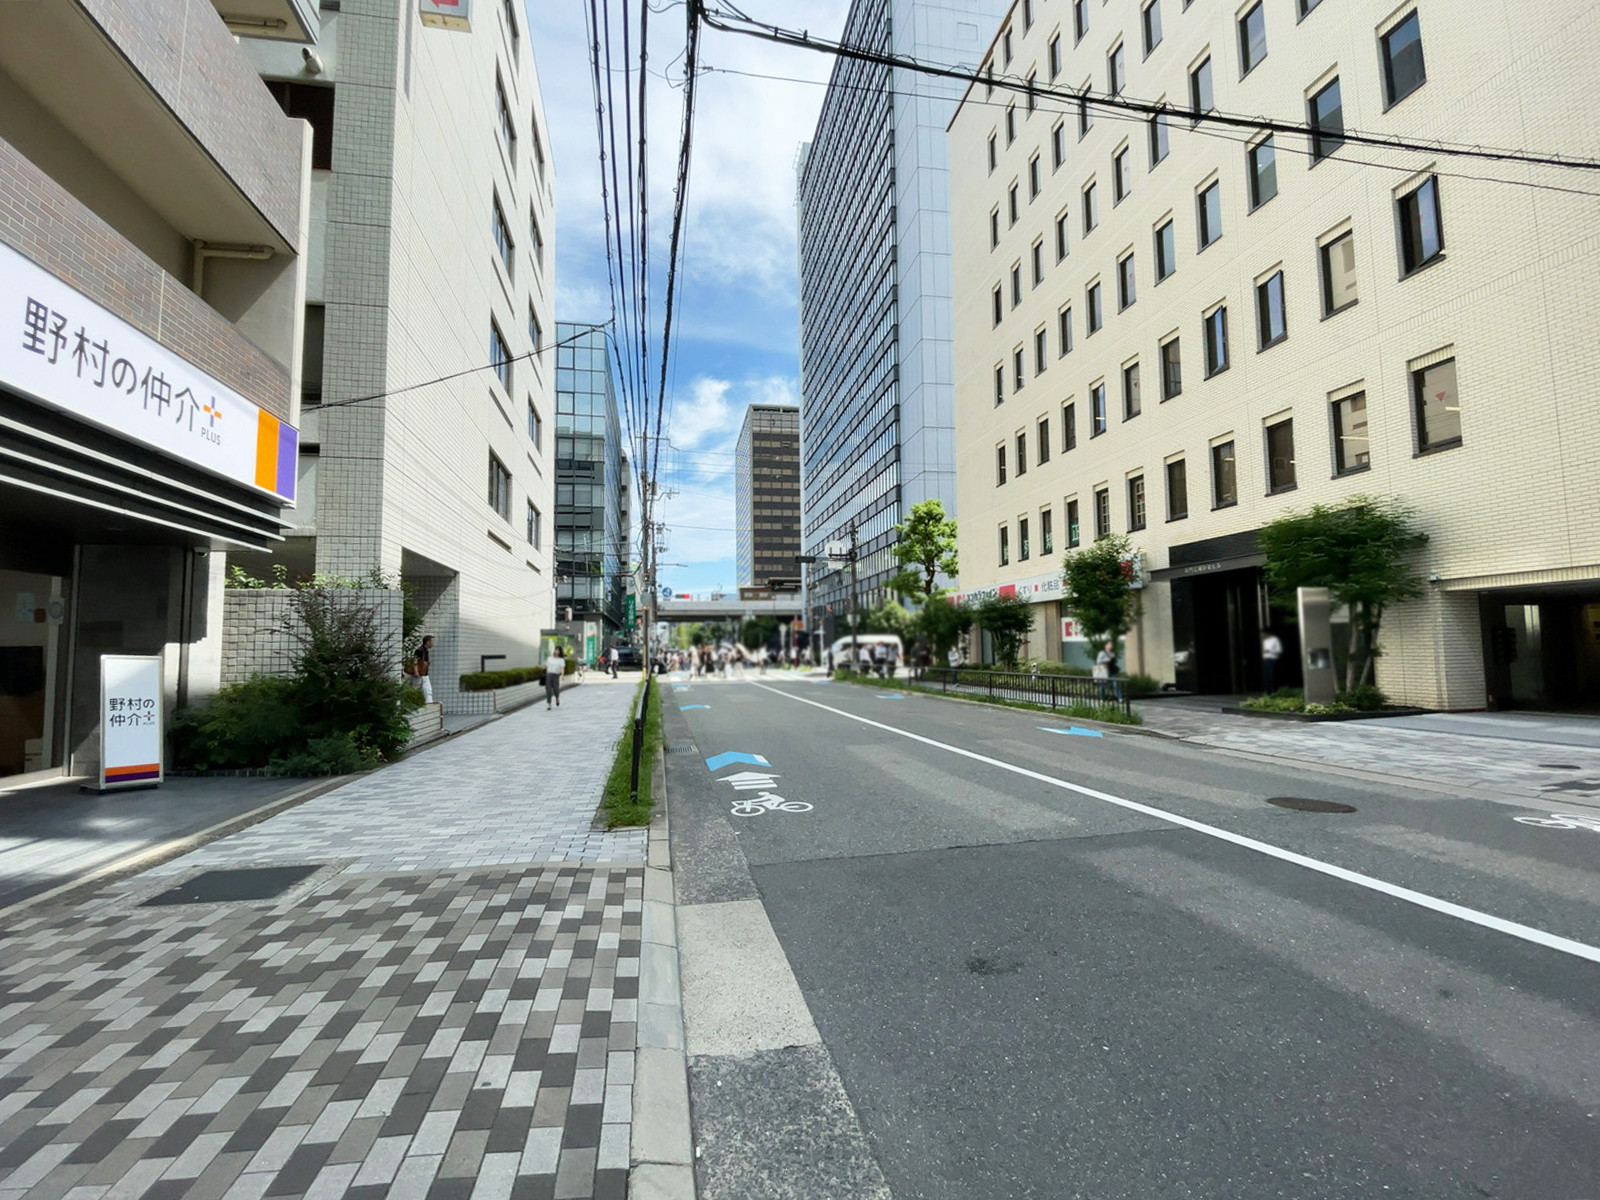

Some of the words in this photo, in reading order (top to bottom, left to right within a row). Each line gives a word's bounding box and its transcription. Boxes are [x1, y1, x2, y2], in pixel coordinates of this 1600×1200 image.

[201, 427, 221, 446] PLUS
[1041, 579, 1060, 592] 化粧品
[109, 697, 155, 711] 野村の
